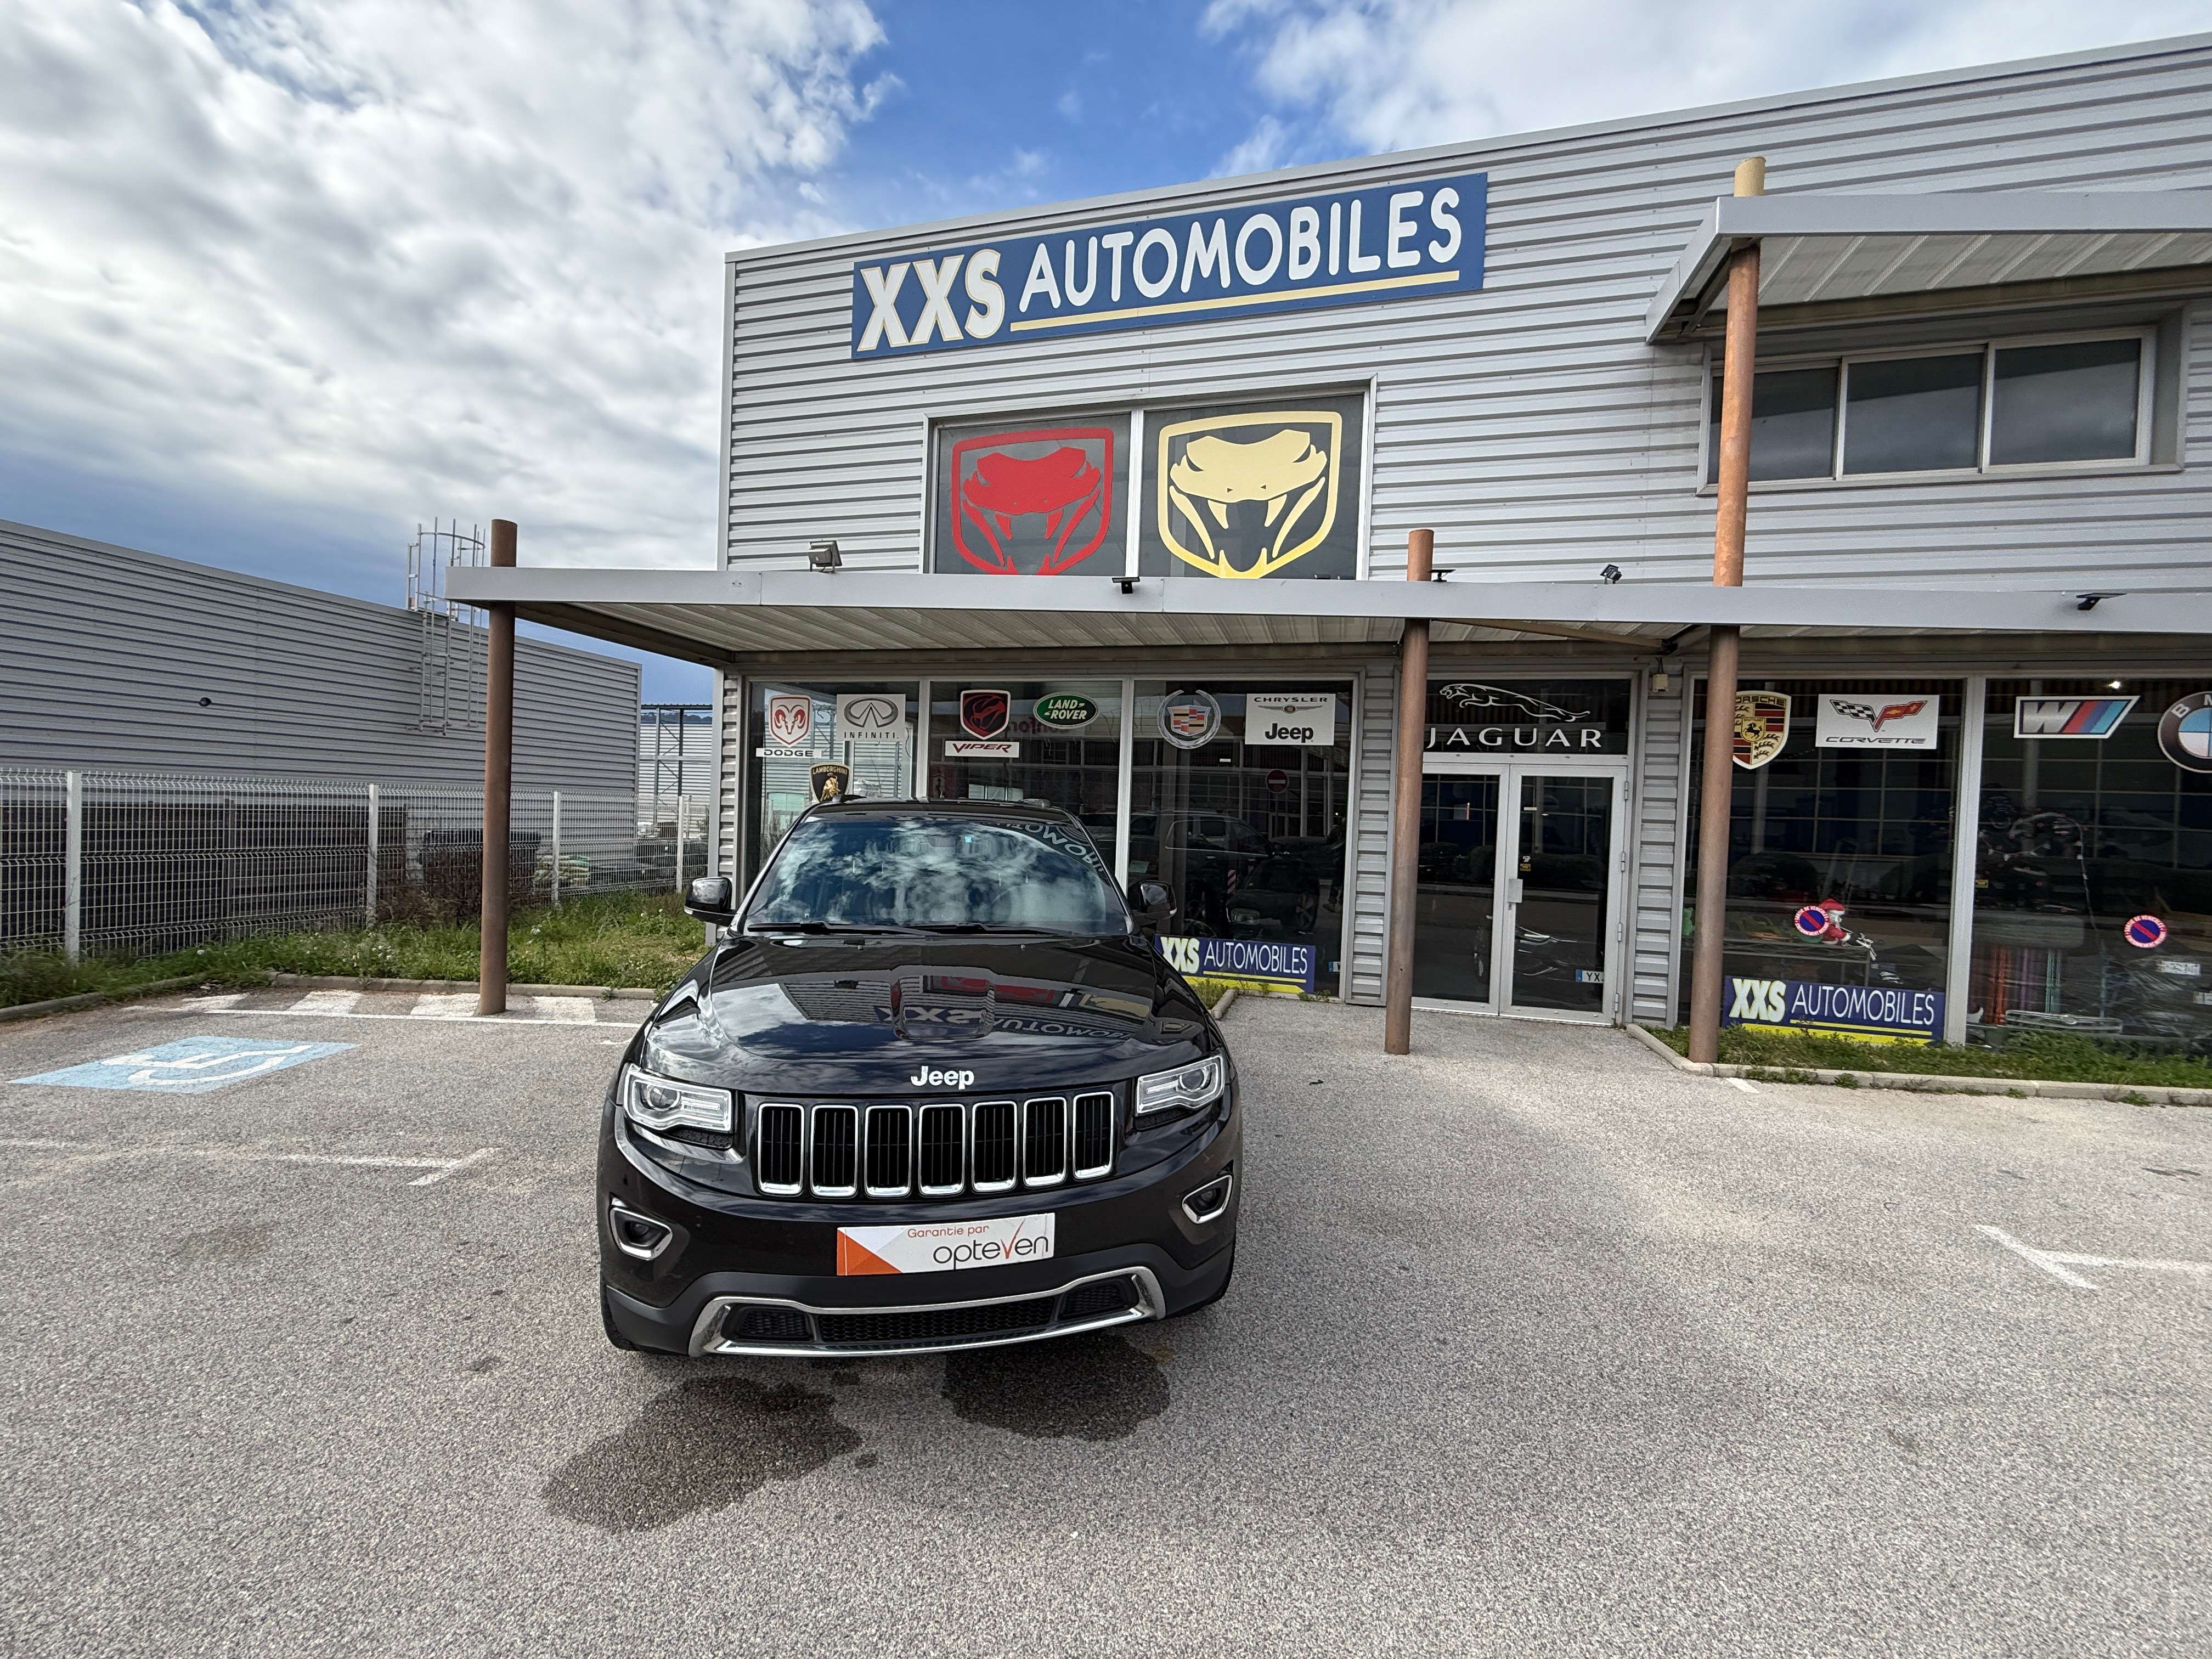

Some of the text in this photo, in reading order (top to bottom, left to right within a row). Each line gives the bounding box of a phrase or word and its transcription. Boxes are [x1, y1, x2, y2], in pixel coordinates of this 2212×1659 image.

[857, 187, 1462, 352] XXS AUTOMOBILES
[1048, 699, 1078, 709] LAND
[1736, 696, 1785, 707] ORSCHE
[2171, 694, 2212, 718] BM
[1051, 710, 1087, 720] ROVER
[1265, 723, 1314, 743] Jeep
[1426, 727, 1602, 749] JAGUAR
[952, 743, 1012, 753] VIPER
[812, 766, 848, 775] LAMBORGHINI
[1160, 936, 1307, 974] XXS AUTOMOBILES
[1729, 978, 1934, 1025] XXS AUTOMOBILES
[911, 1065, 974, 1090] Jeep
[907, 1226, 989, 1239] Garantie par
